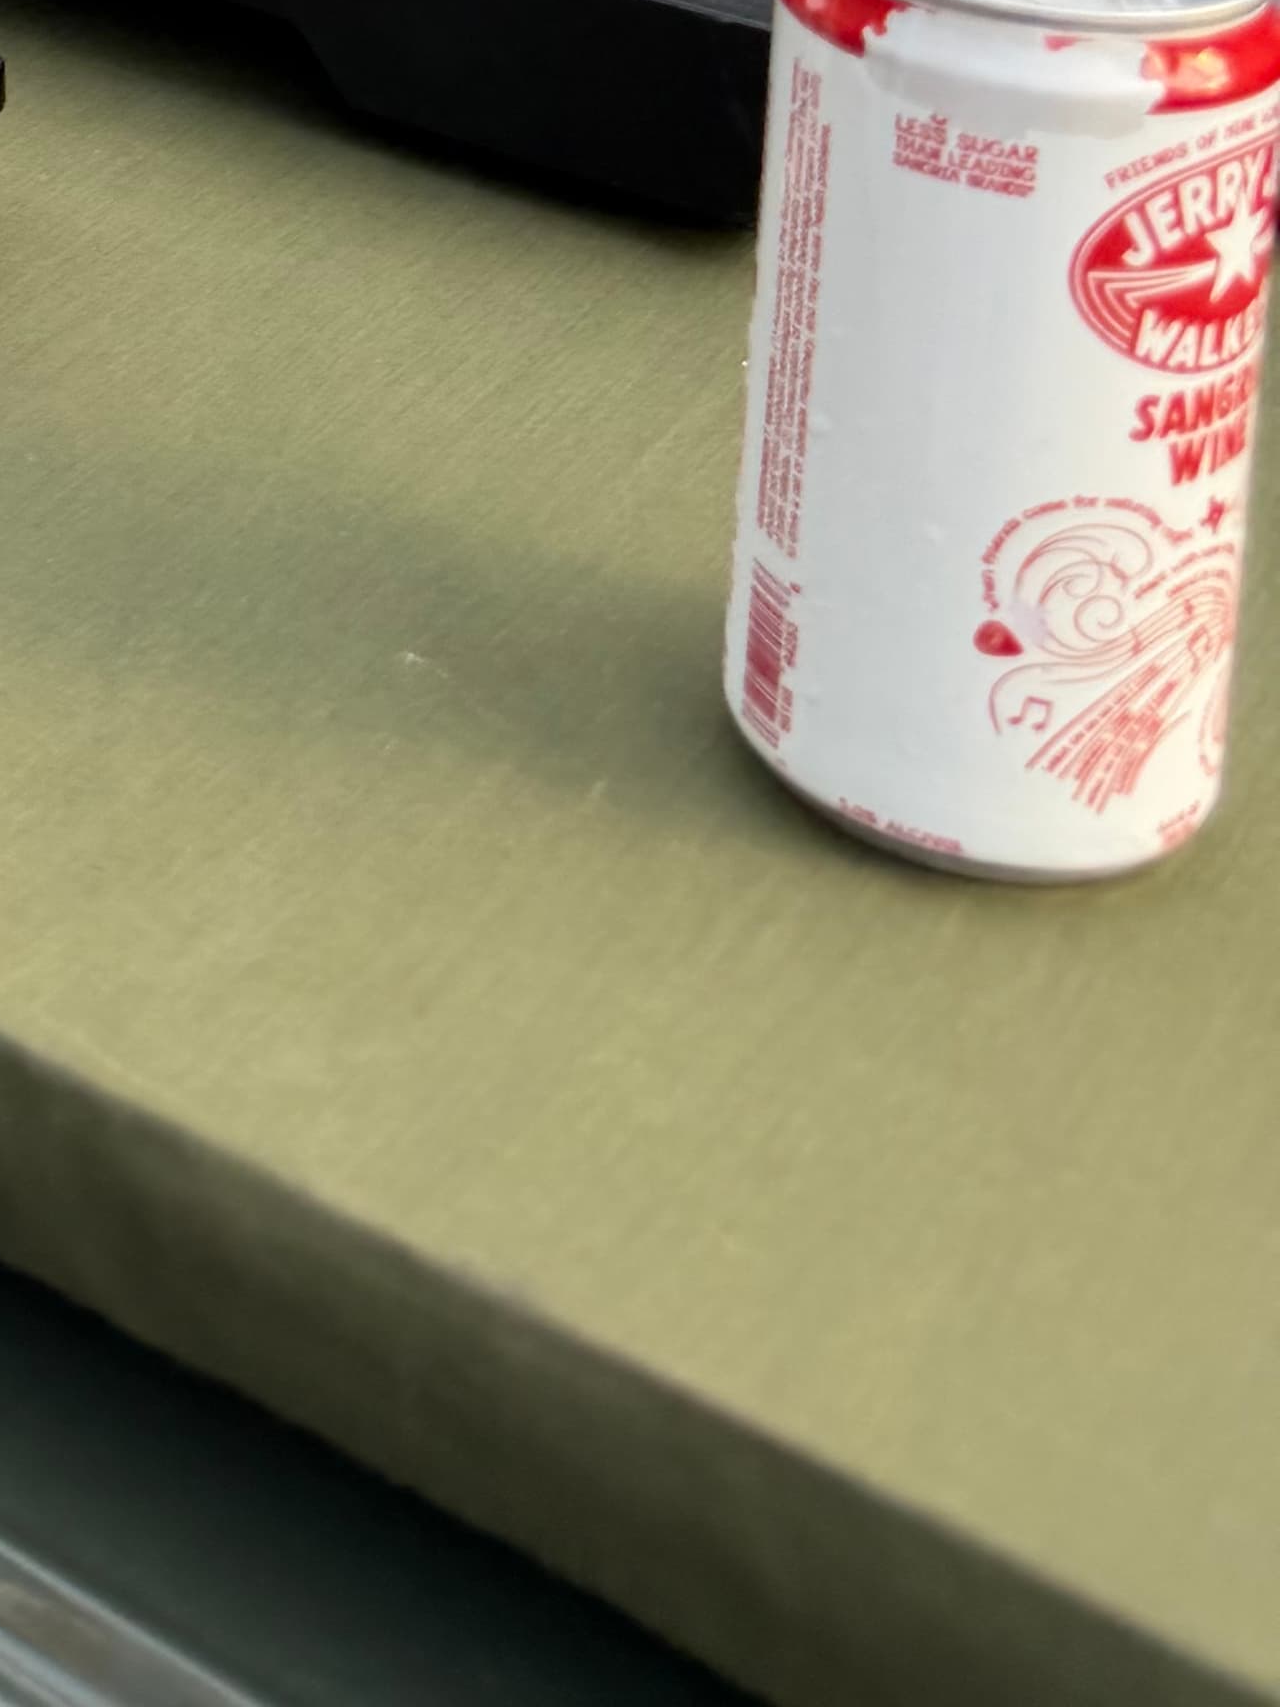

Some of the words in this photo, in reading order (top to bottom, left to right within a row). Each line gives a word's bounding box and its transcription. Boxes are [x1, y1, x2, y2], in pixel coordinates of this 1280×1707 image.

[956, 133, 1038, 164] SUGAR
[947, 150, 1036, 182] LEADING
[1122, 151, 1269, 268] JERRY
